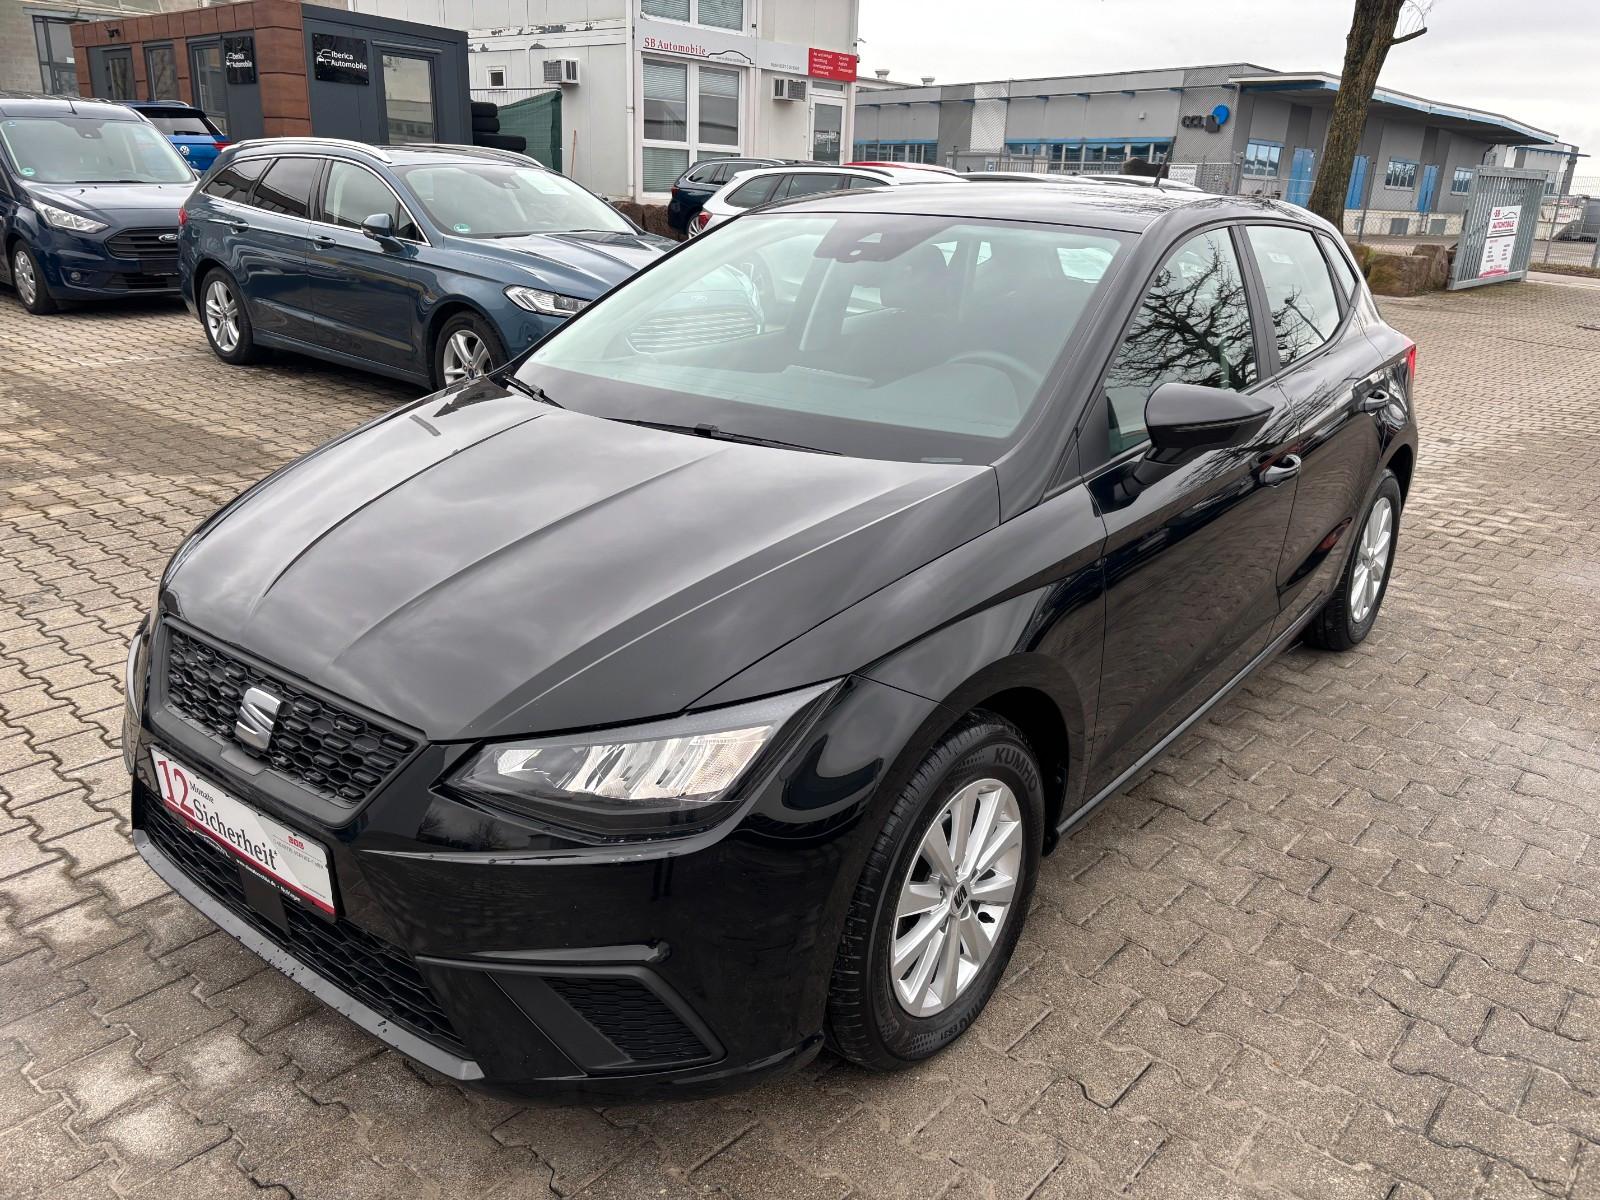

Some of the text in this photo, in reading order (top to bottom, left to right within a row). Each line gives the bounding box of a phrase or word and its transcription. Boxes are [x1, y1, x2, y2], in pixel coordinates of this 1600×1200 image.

[331, 50, 354, 60] Iberica
[644, 37, 706, 56] SB Automobile
[330, 59, 368, 70] Automobile
[993, 747, 1038, 793] KUMHO
[157, 760, 214, 818] 12 Monate
